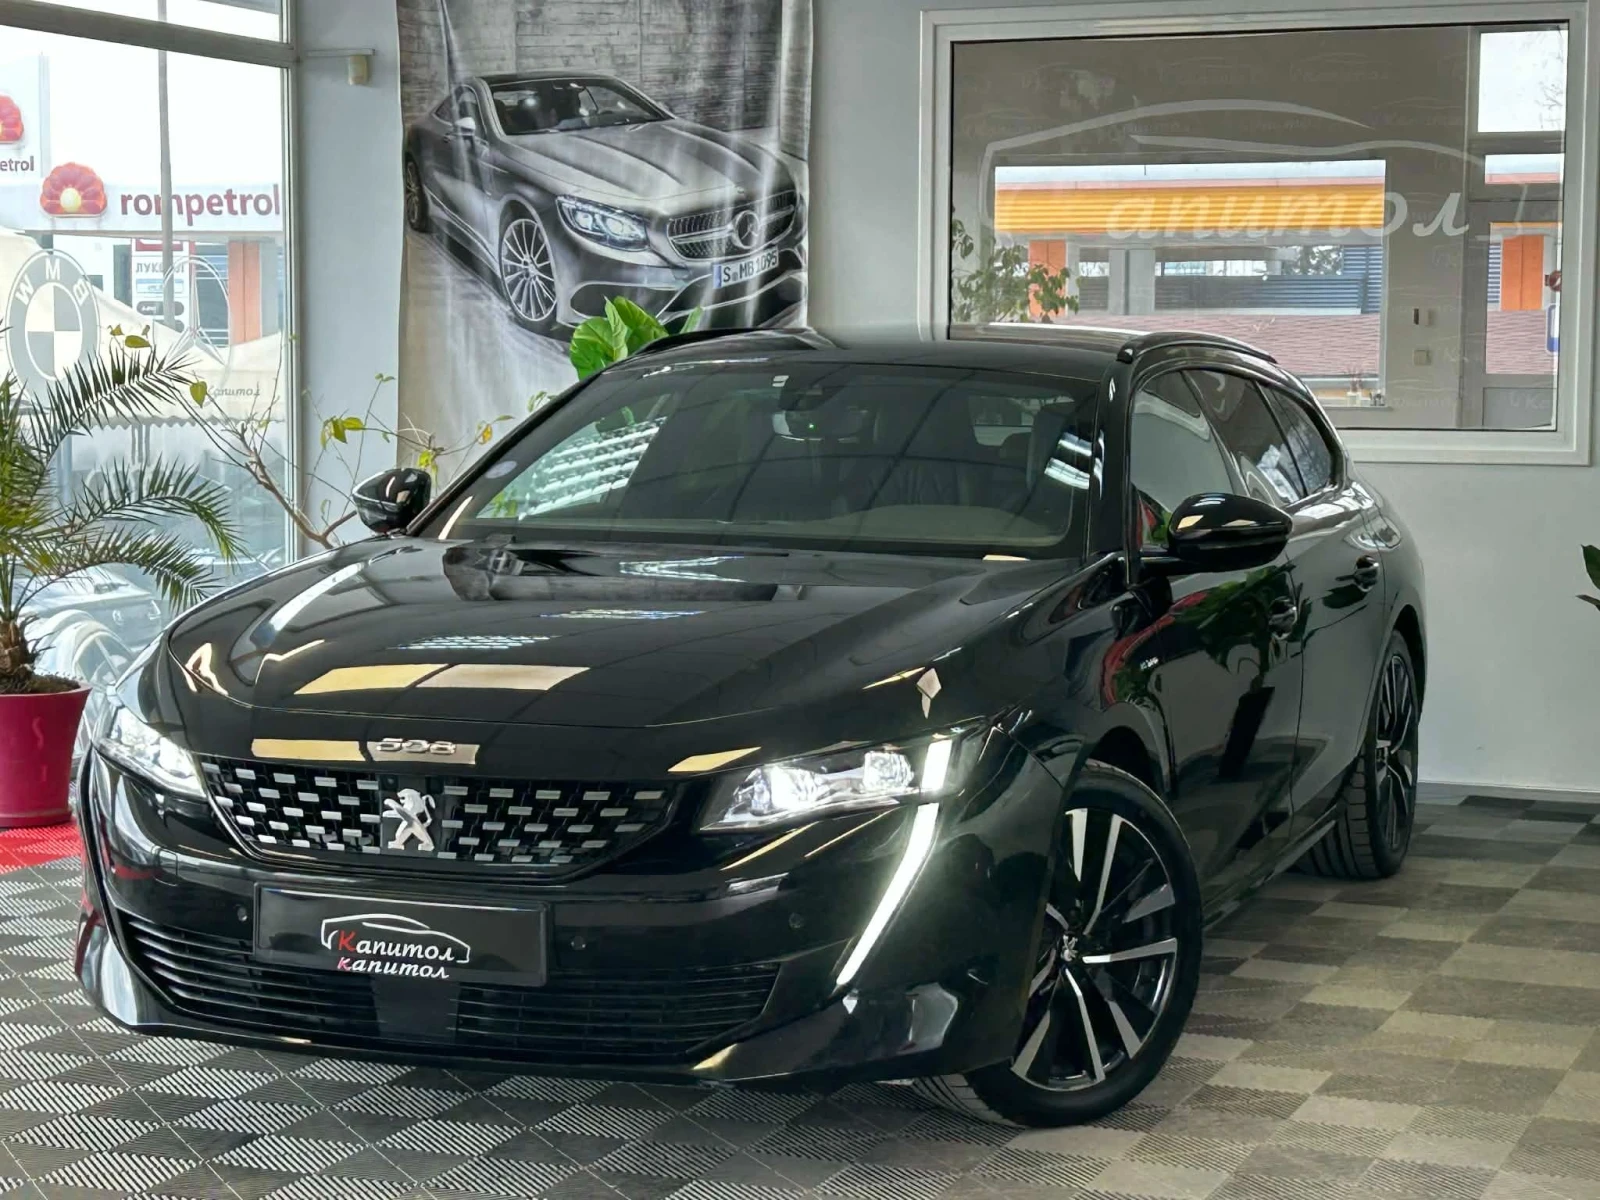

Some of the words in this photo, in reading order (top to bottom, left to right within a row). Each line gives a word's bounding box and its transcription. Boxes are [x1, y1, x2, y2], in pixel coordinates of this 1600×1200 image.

[120, 183, 280, 226] rompetrol
[1104, 191, 1469, 239] апитол
[136, 262, 184, 273] ЛУКЛ
[723, 267, 731, 282] S
[740, 261, 754, 279] MB
[377, 738, 456, 755] 508
[338, 930, 455, 962] Капитол
